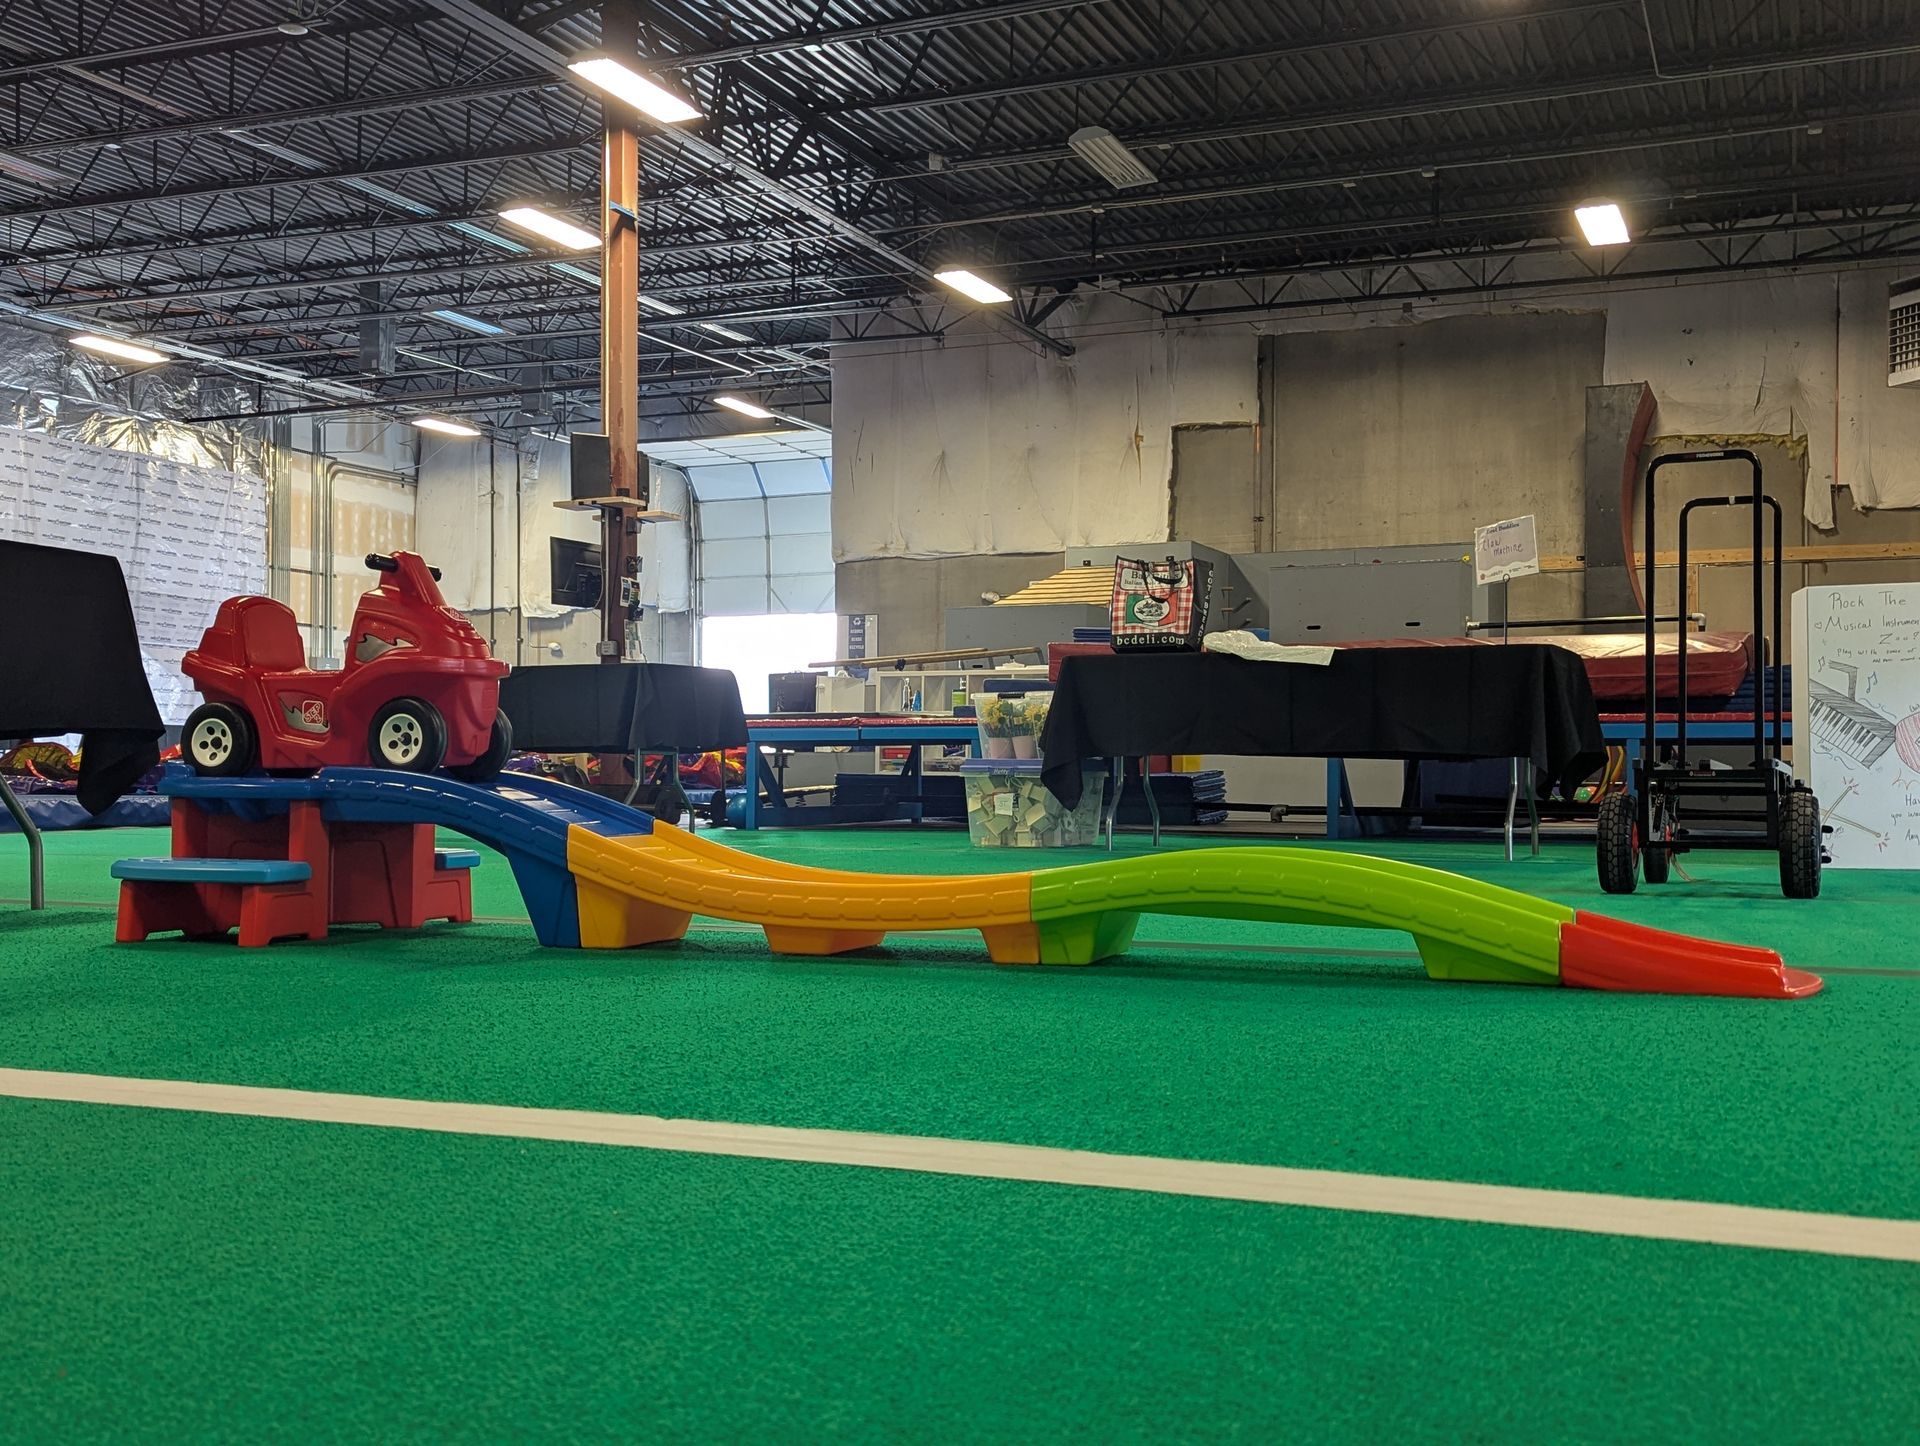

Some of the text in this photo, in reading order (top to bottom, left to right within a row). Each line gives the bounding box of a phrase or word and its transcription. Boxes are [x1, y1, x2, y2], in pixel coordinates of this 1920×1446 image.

[1482, 538, 1501, 551] Claw
[1828, 590, 1907, 611] Rock The
[1824, 615, 1872, 633] Musical
[1116, 634, 1184, 645] bcdeli.com
